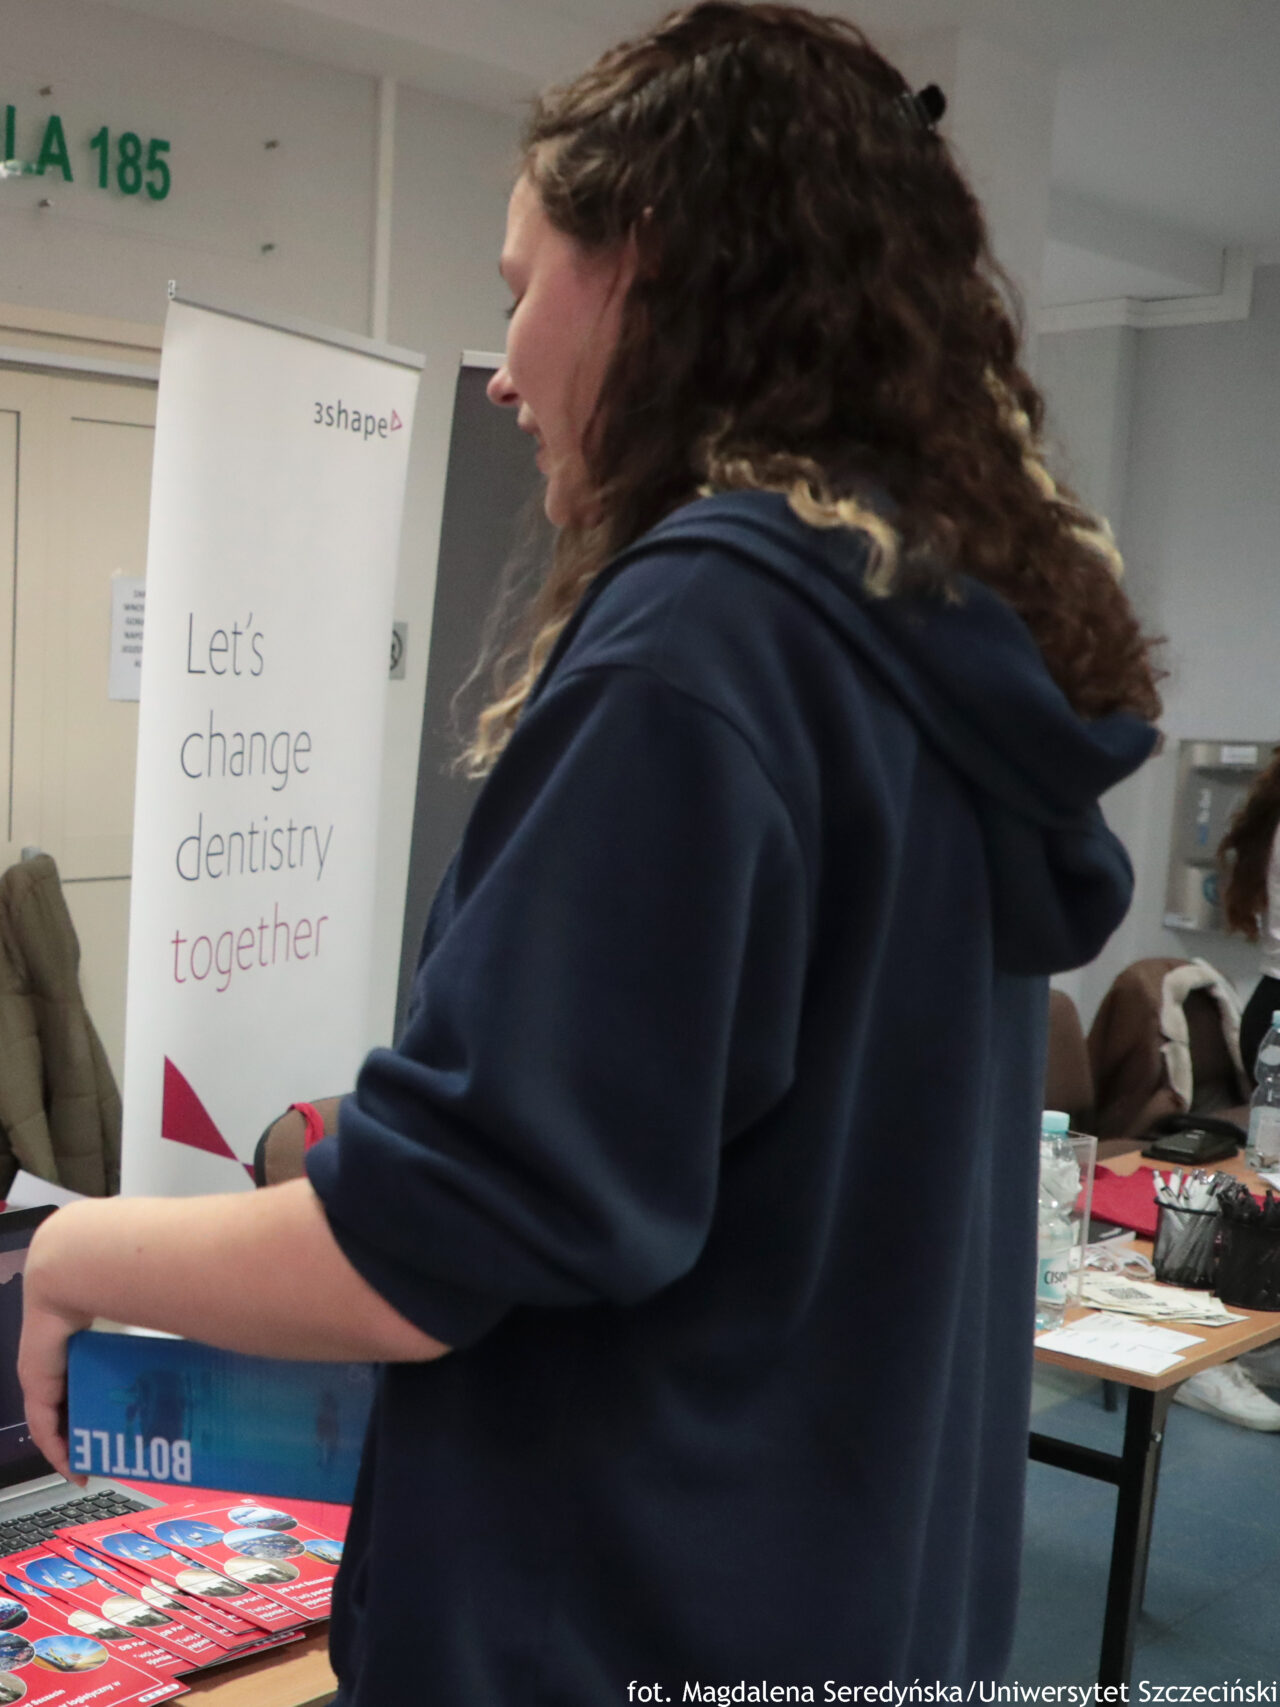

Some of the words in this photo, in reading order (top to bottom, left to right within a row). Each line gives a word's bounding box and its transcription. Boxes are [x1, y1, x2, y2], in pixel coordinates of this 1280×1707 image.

[89, 125, 171, 201] 185
[313, 399, 388, 441] 3shape
[187, 612, 265, 677] Let's
[180, 709, 313, 792] change
[176, 812, 334, 881] dentistry
[170, 902, 330, 993] together
[73, 1427, 192, 1483] BOTTLE
